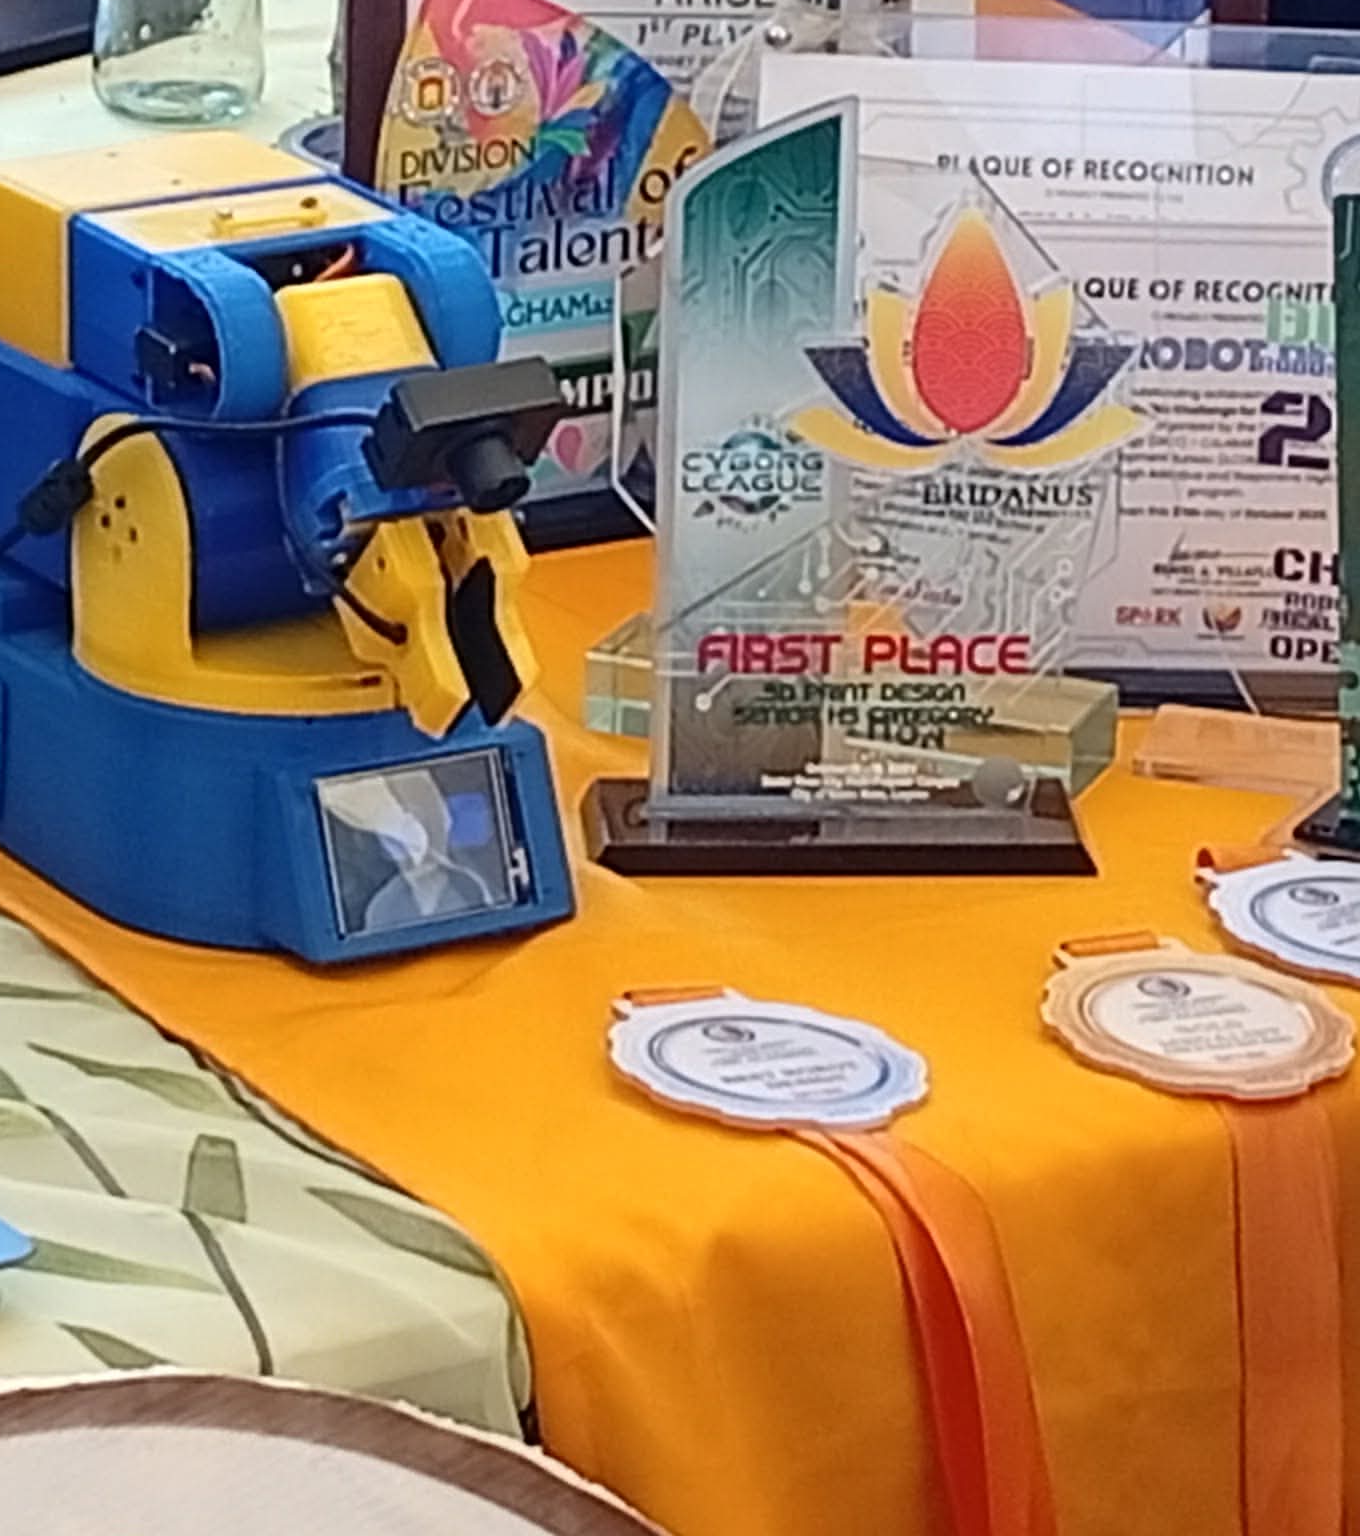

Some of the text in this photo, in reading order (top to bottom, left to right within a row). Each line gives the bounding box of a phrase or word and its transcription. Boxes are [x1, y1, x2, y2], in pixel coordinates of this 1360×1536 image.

[400, 135, 537, 180] DIVISION
[1042, 158, 1074, 179] OF
[1083, 160, 1255, 186] RECOGNITION
[1149, 279, 1184, 302] OF
[682, 451, 824, 472] CYBORG
[682, 473, 823, 493] LEAGUE
[697, 632, 1032, 675] FIRST PLACE
[881, 682, 966, 703] DESIGN
